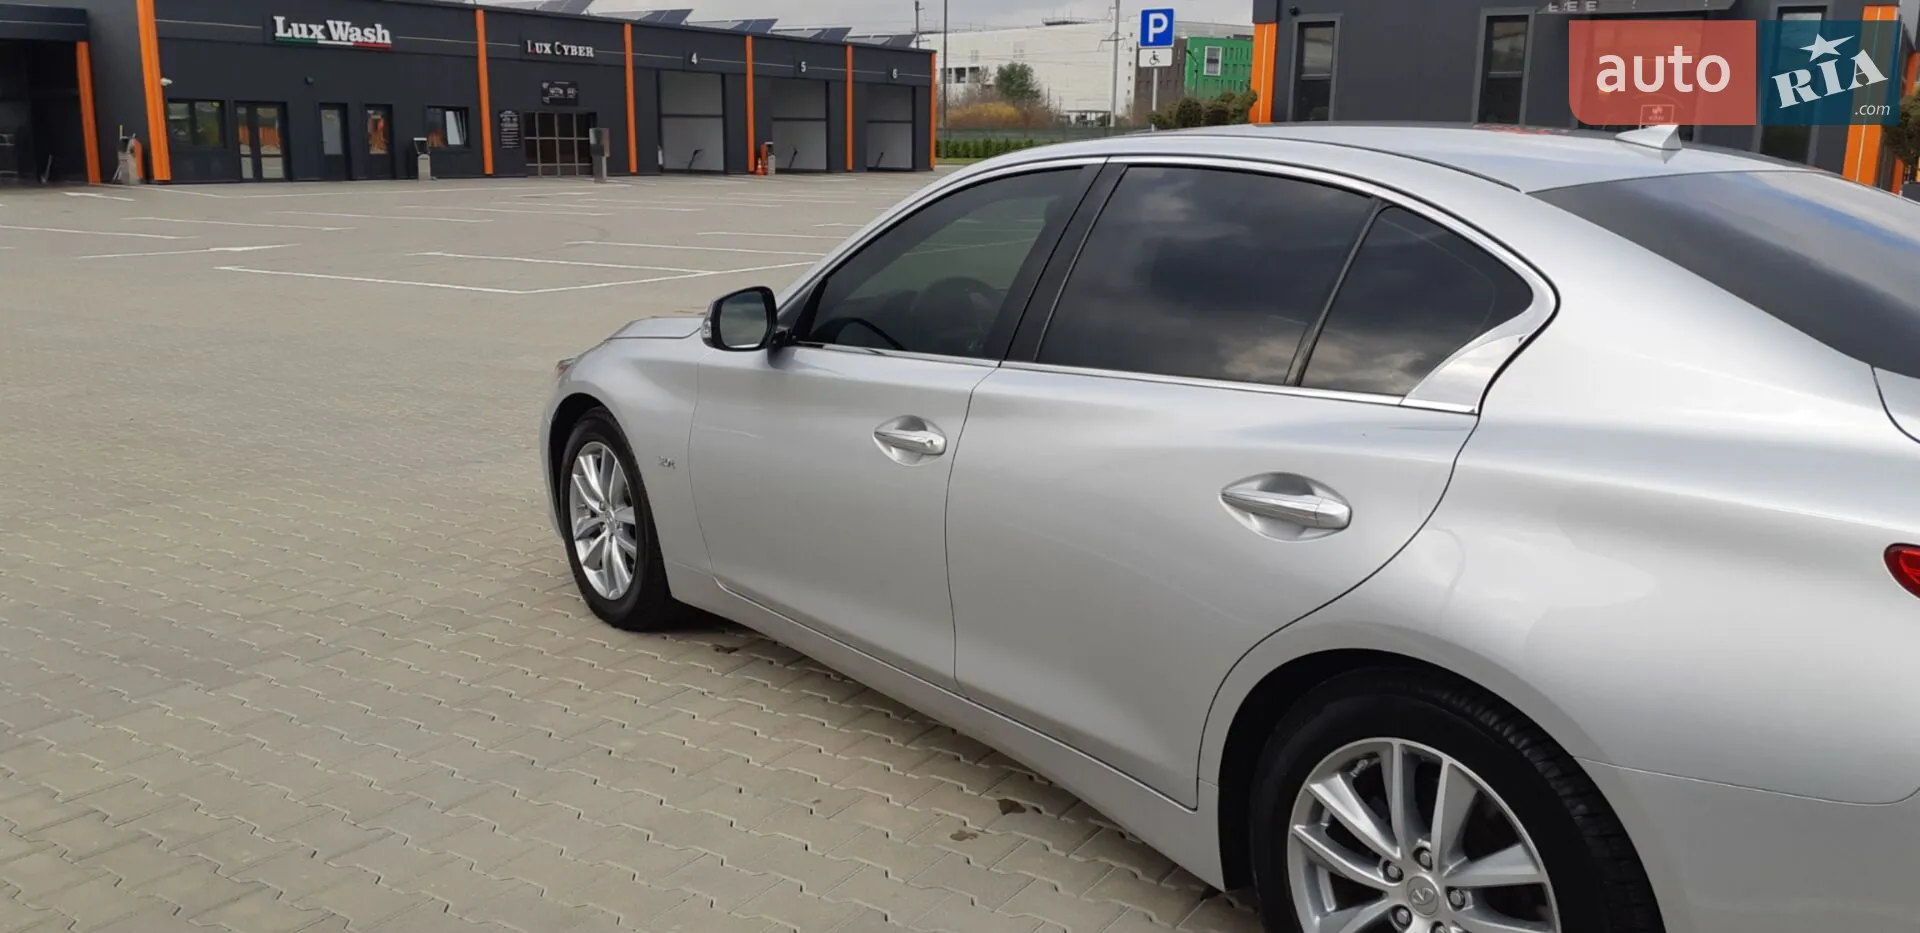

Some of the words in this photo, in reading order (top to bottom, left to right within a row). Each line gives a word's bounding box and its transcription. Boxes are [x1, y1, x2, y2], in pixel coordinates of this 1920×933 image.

[273, 15, 326, 39] Lux
[326, 20, 392, 44] Wash
[1148, 13, 1168, 42] P
[554, 41, 594, 58] CYBER
[691, 52, 698, 65] 4
[800, 60, 807, 73] 5
[892, 68, 898, 79] 6
